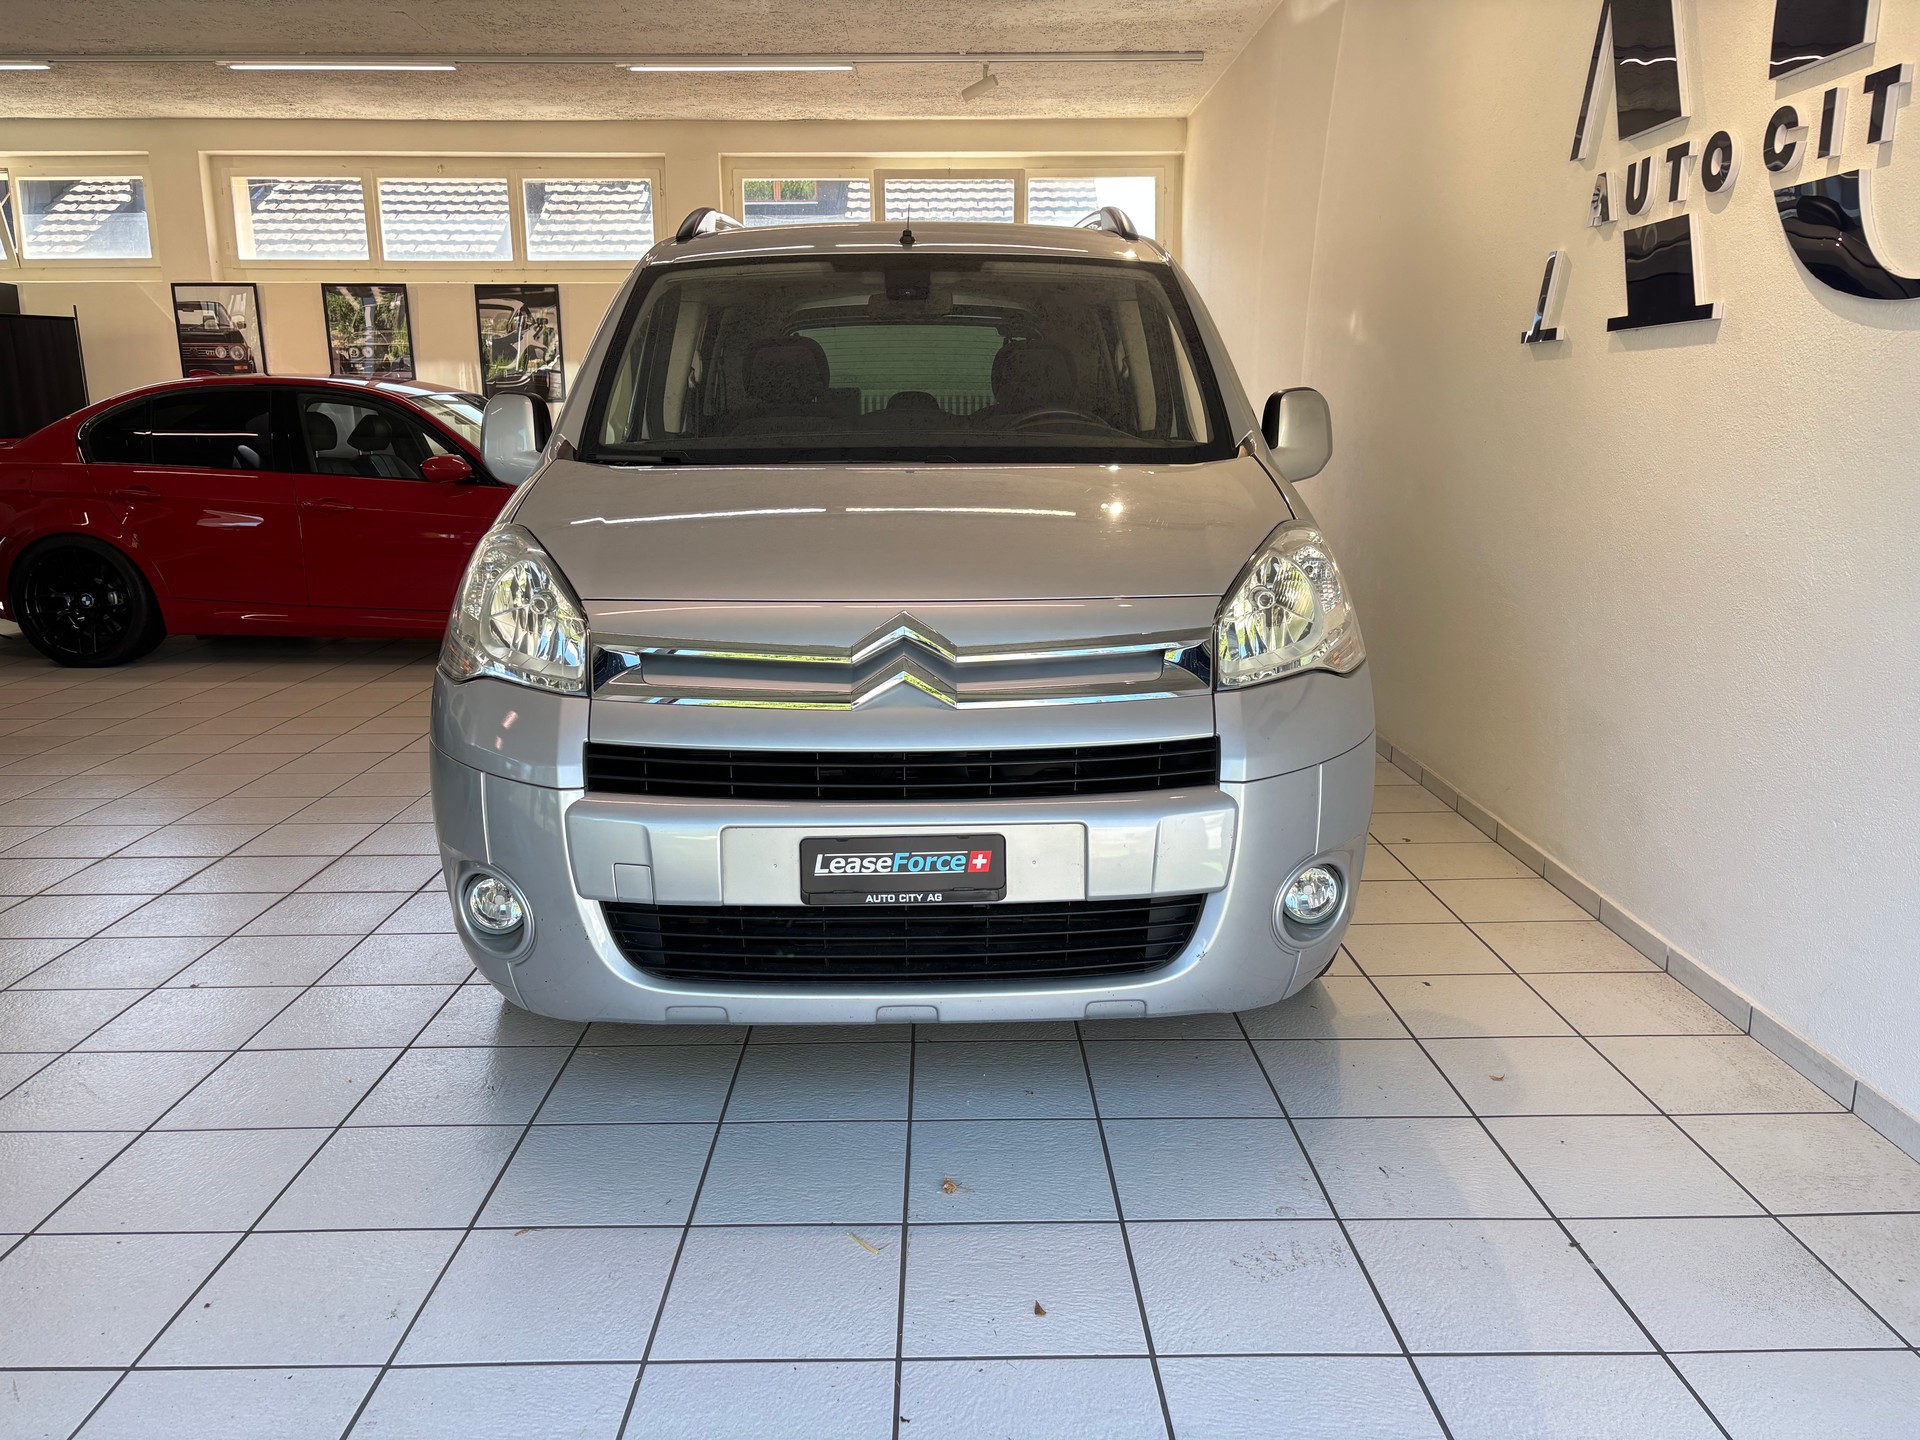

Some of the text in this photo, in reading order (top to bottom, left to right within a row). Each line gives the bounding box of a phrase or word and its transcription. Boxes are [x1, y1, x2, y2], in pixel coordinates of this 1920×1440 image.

[1587, 130, 1738, 227] AUTO
[814, 852, 967, 874] LeaseForce
[865, 893, 943, 903] AUTO CITY AG
